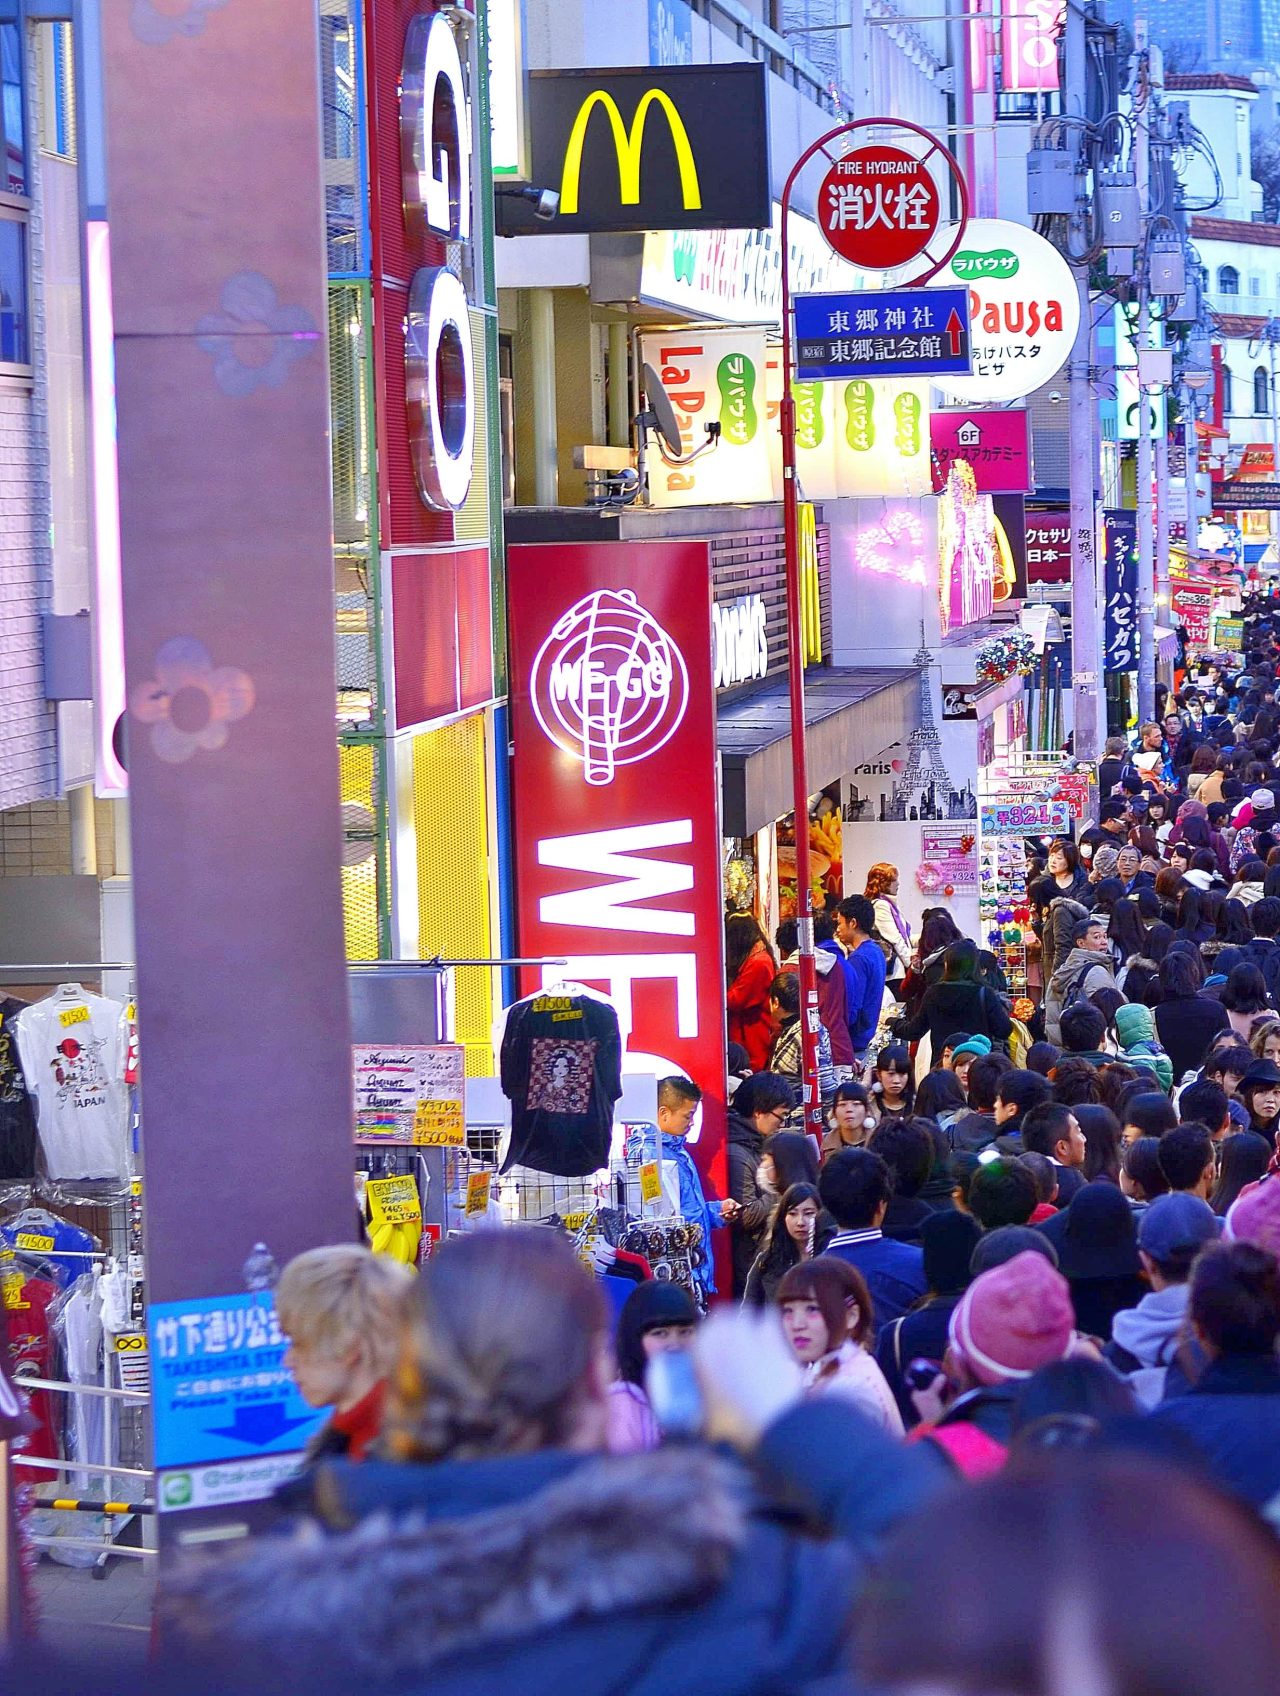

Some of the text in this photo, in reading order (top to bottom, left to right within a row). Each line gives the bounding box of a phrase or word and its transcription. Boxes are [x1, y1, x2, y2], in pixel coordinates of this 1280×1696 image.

[837, 161, 919, 175] FIRE HYDRANT
[828, 183, 931, 230] 消火栓
[952, 256, 1017, 272] ラパウザ
[827, 307, 935, 333] 東郷神社
[829, 336, 942, 363] 東郷記念館
[728, 357, 749, 441] ラパウザ
[800, 383, 817, 446] パウザ
[961, 430, 978, 442] 6F
[932, 447, 1022, 463] ダンスアカデミー
[1108, 592, 1135, 670] ハセガワ
[997, 805, 1051, 827] ¥324
[74, 1097, 106, 1108] JAPAN
